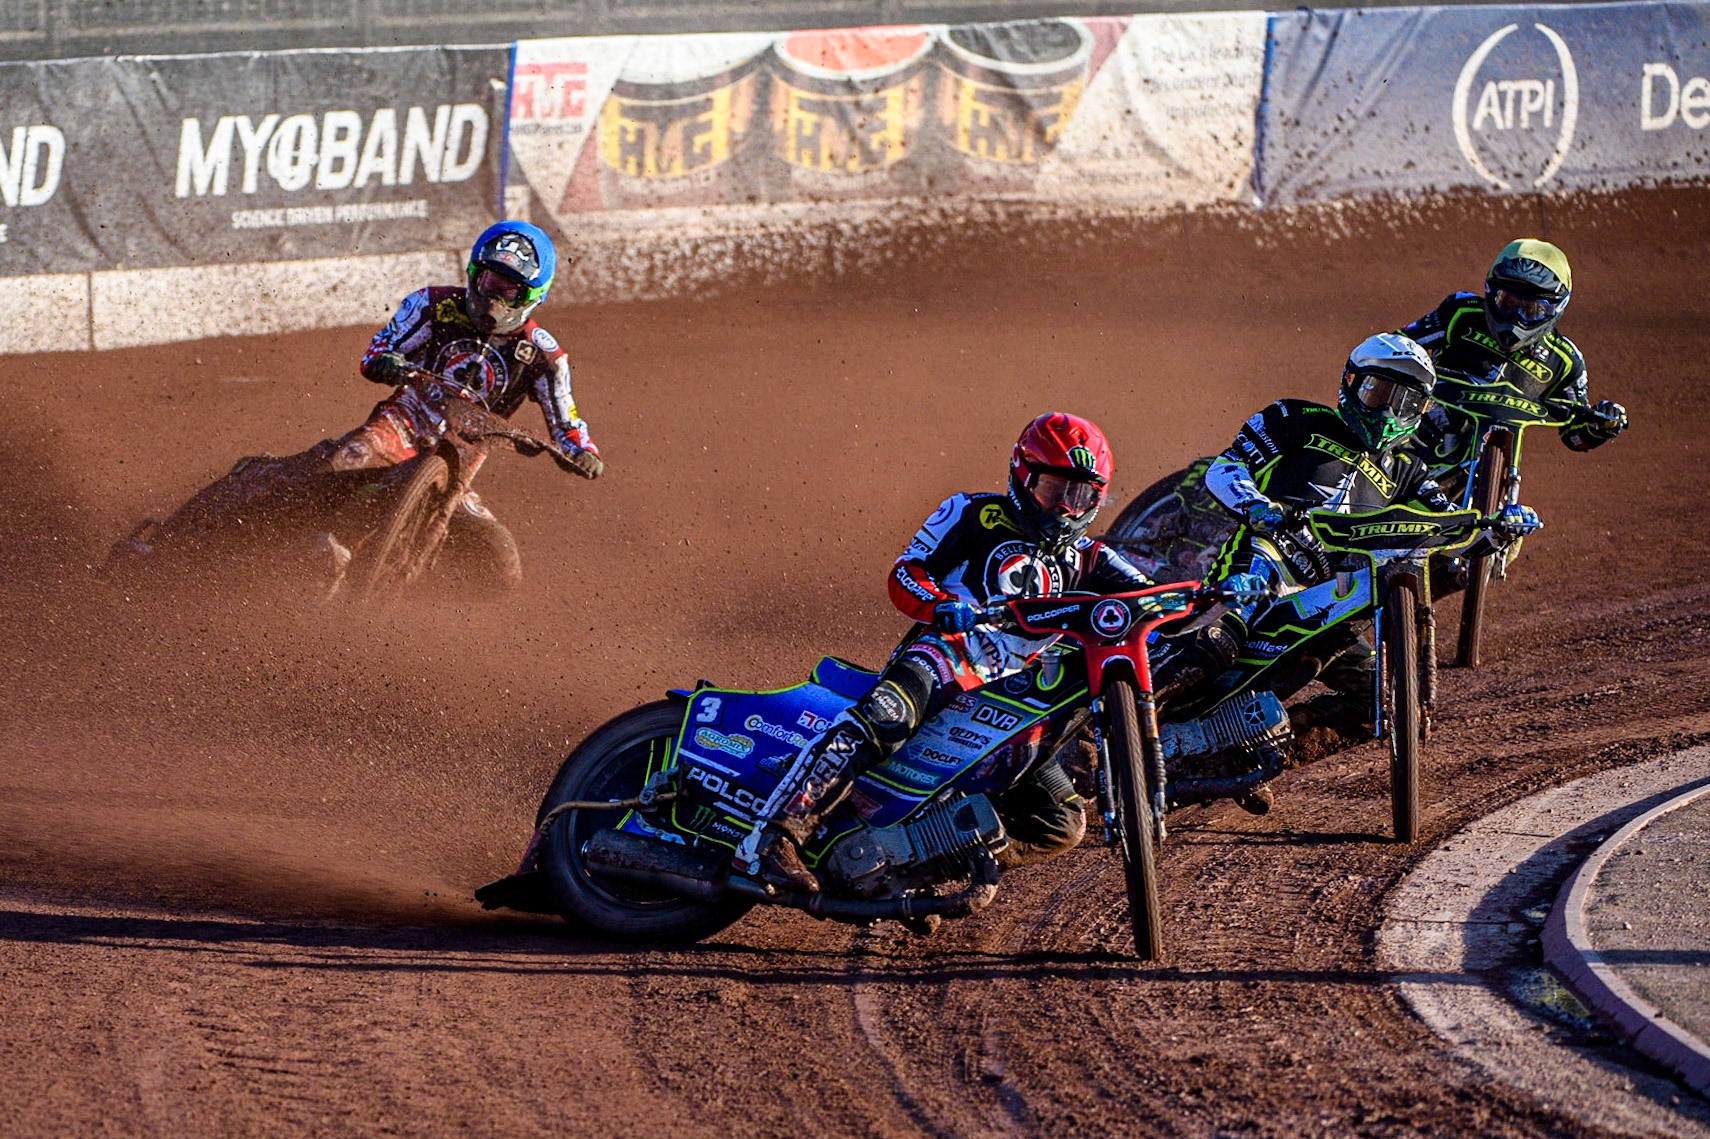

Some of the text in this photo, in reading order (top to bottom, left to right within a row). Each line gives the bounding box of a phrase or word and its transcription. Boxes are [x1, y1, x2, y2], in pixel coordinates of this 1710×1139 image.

[1472, 79, 1555, 130] ATPI
[1640, 62, 1710, 130] De
[231, 208, 286, 229] SCIENCE
[1504, 397, 1542, 415] MIX
[1359, 459, 1394, 495] MIX
[1358, 524, 1396, 537] TRU
[994, 545, 1024, 561] BELLE
[1026, 603, 1081, 623] POLCOPPER
[696, 697, 722, 722] 3
[975, 705, 1019, 731] DVR
[921, 747, 964, 765] DOCUFY
